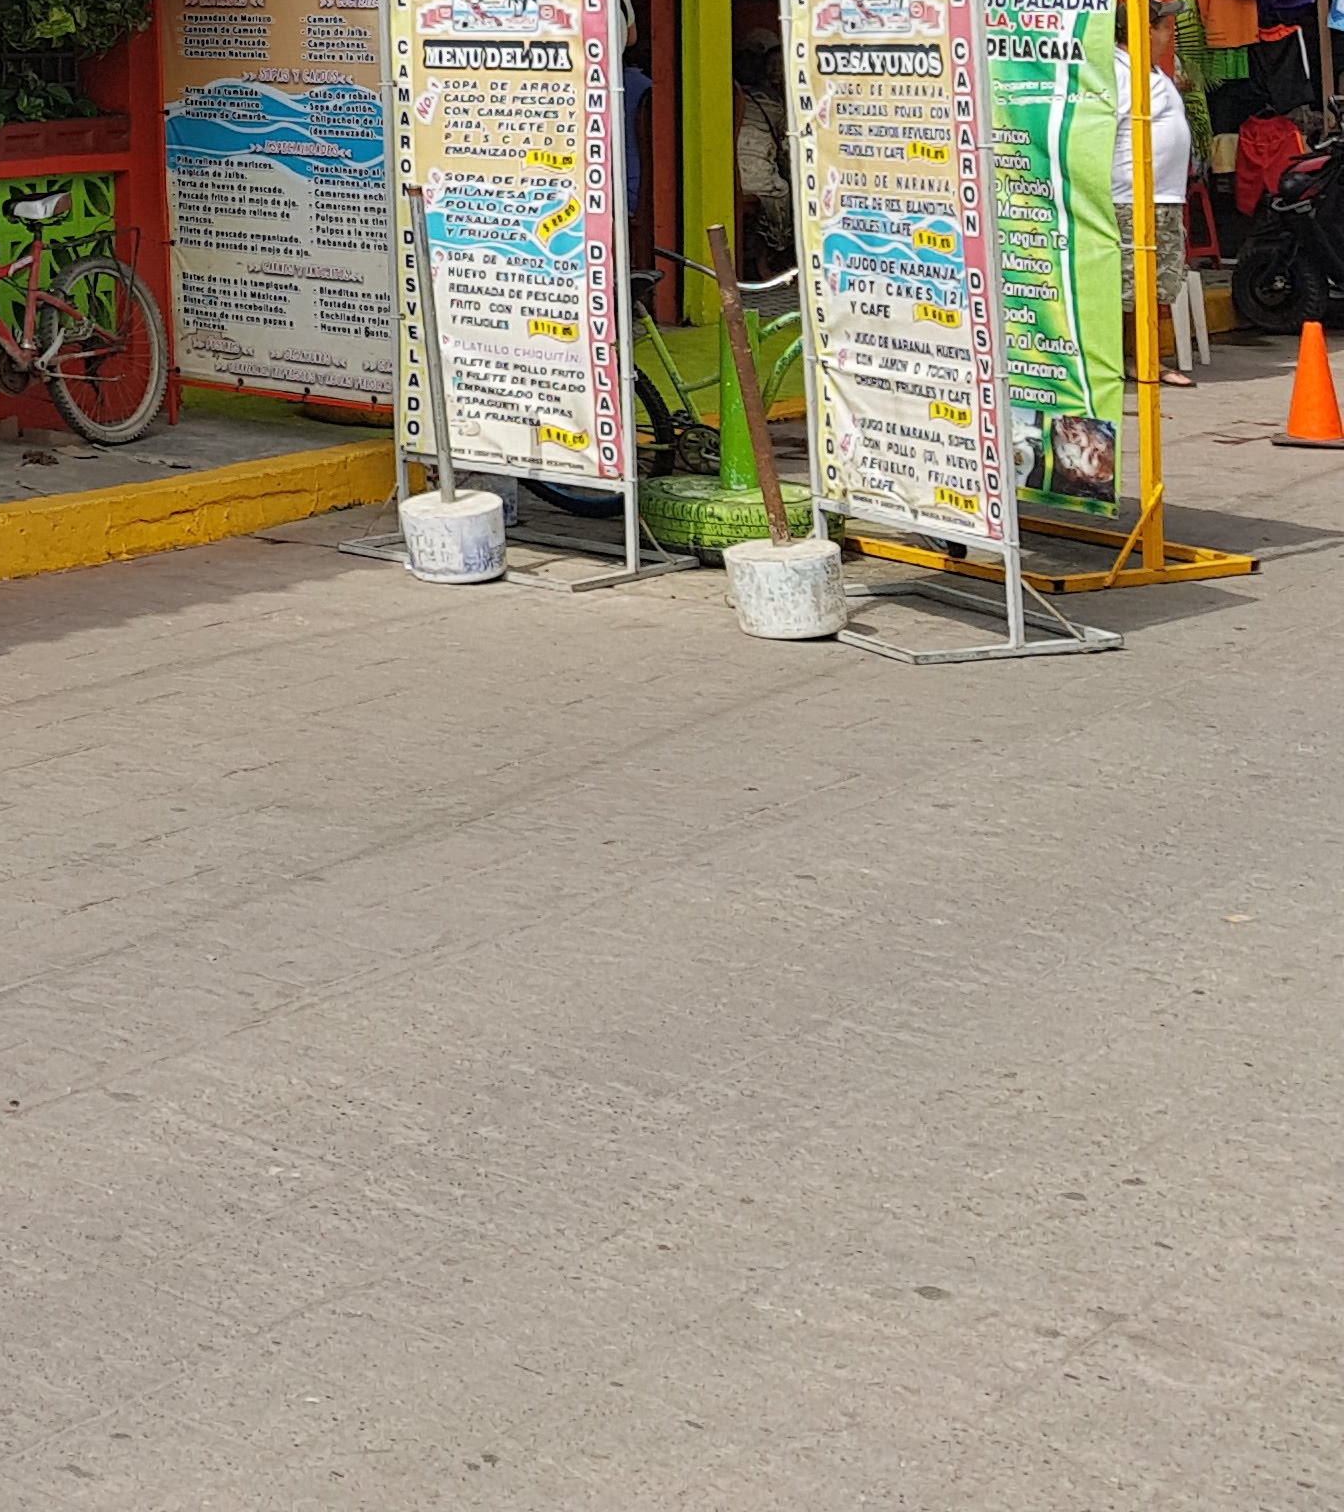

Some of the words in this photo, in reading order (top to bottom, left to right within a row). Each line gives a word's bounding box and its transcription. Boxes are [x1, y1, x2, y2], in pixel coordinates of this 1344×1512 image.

[1021, 15, 1064, 29] VER.
[426, 45, 484, 69] MENU
[485, 45, 527, 70] DEL
[531, 46, 571, 71] DIA
[987, 39, 1006, 57] DE
[1014, 39, 1033, 58] LA
[1039, 40, 1083, 60] CASA
[819, 49, 943, 76] DESAYUNOS
